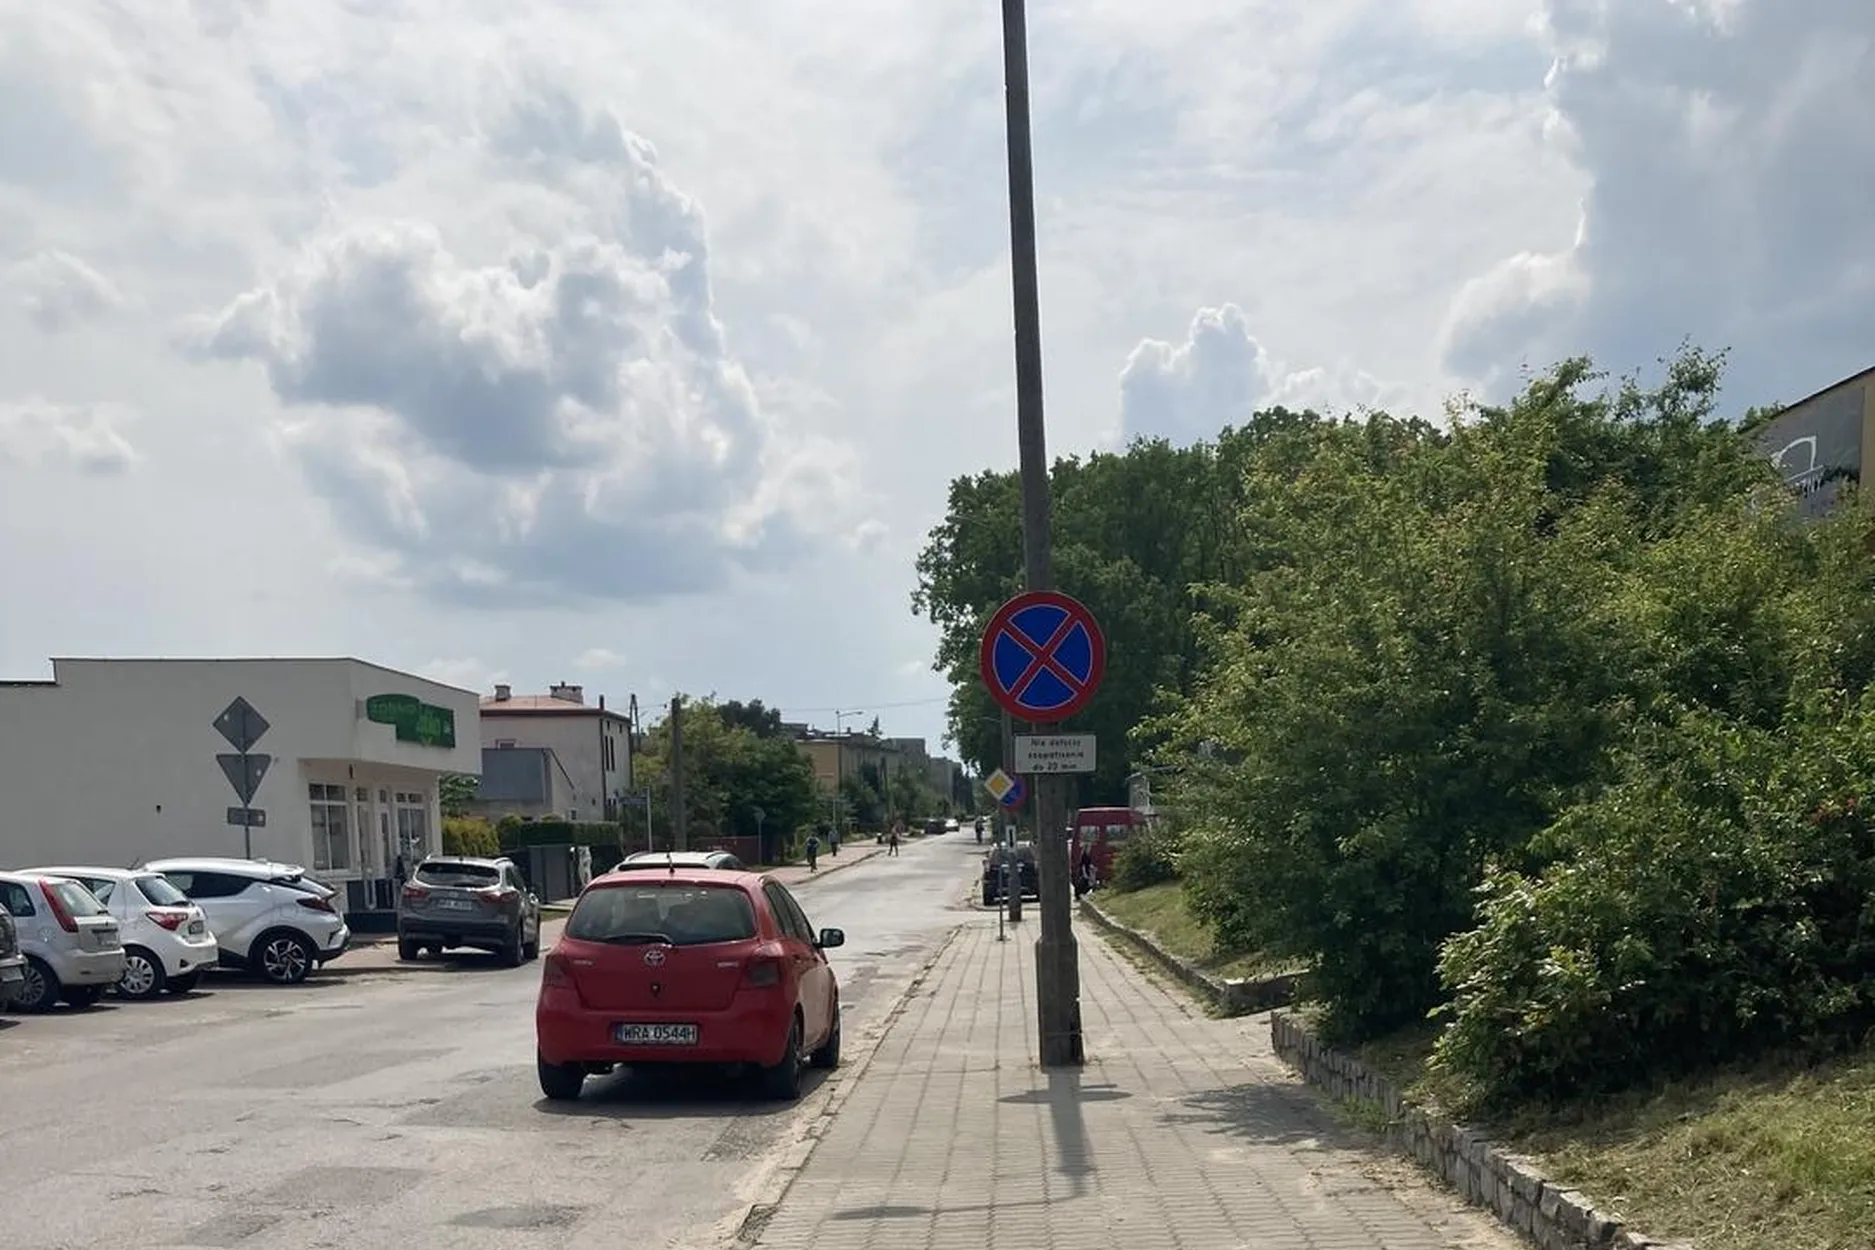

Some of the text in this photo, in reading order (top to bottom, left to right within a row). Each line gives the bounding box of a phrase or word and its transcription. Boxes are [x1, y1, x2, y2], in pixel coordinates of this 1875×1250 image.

[1030, 738, 1081, 748] Nie dotyczy
[1032, 763, 1044, 771] do
[624, 1025, 696, 1040] WRA 0544H
